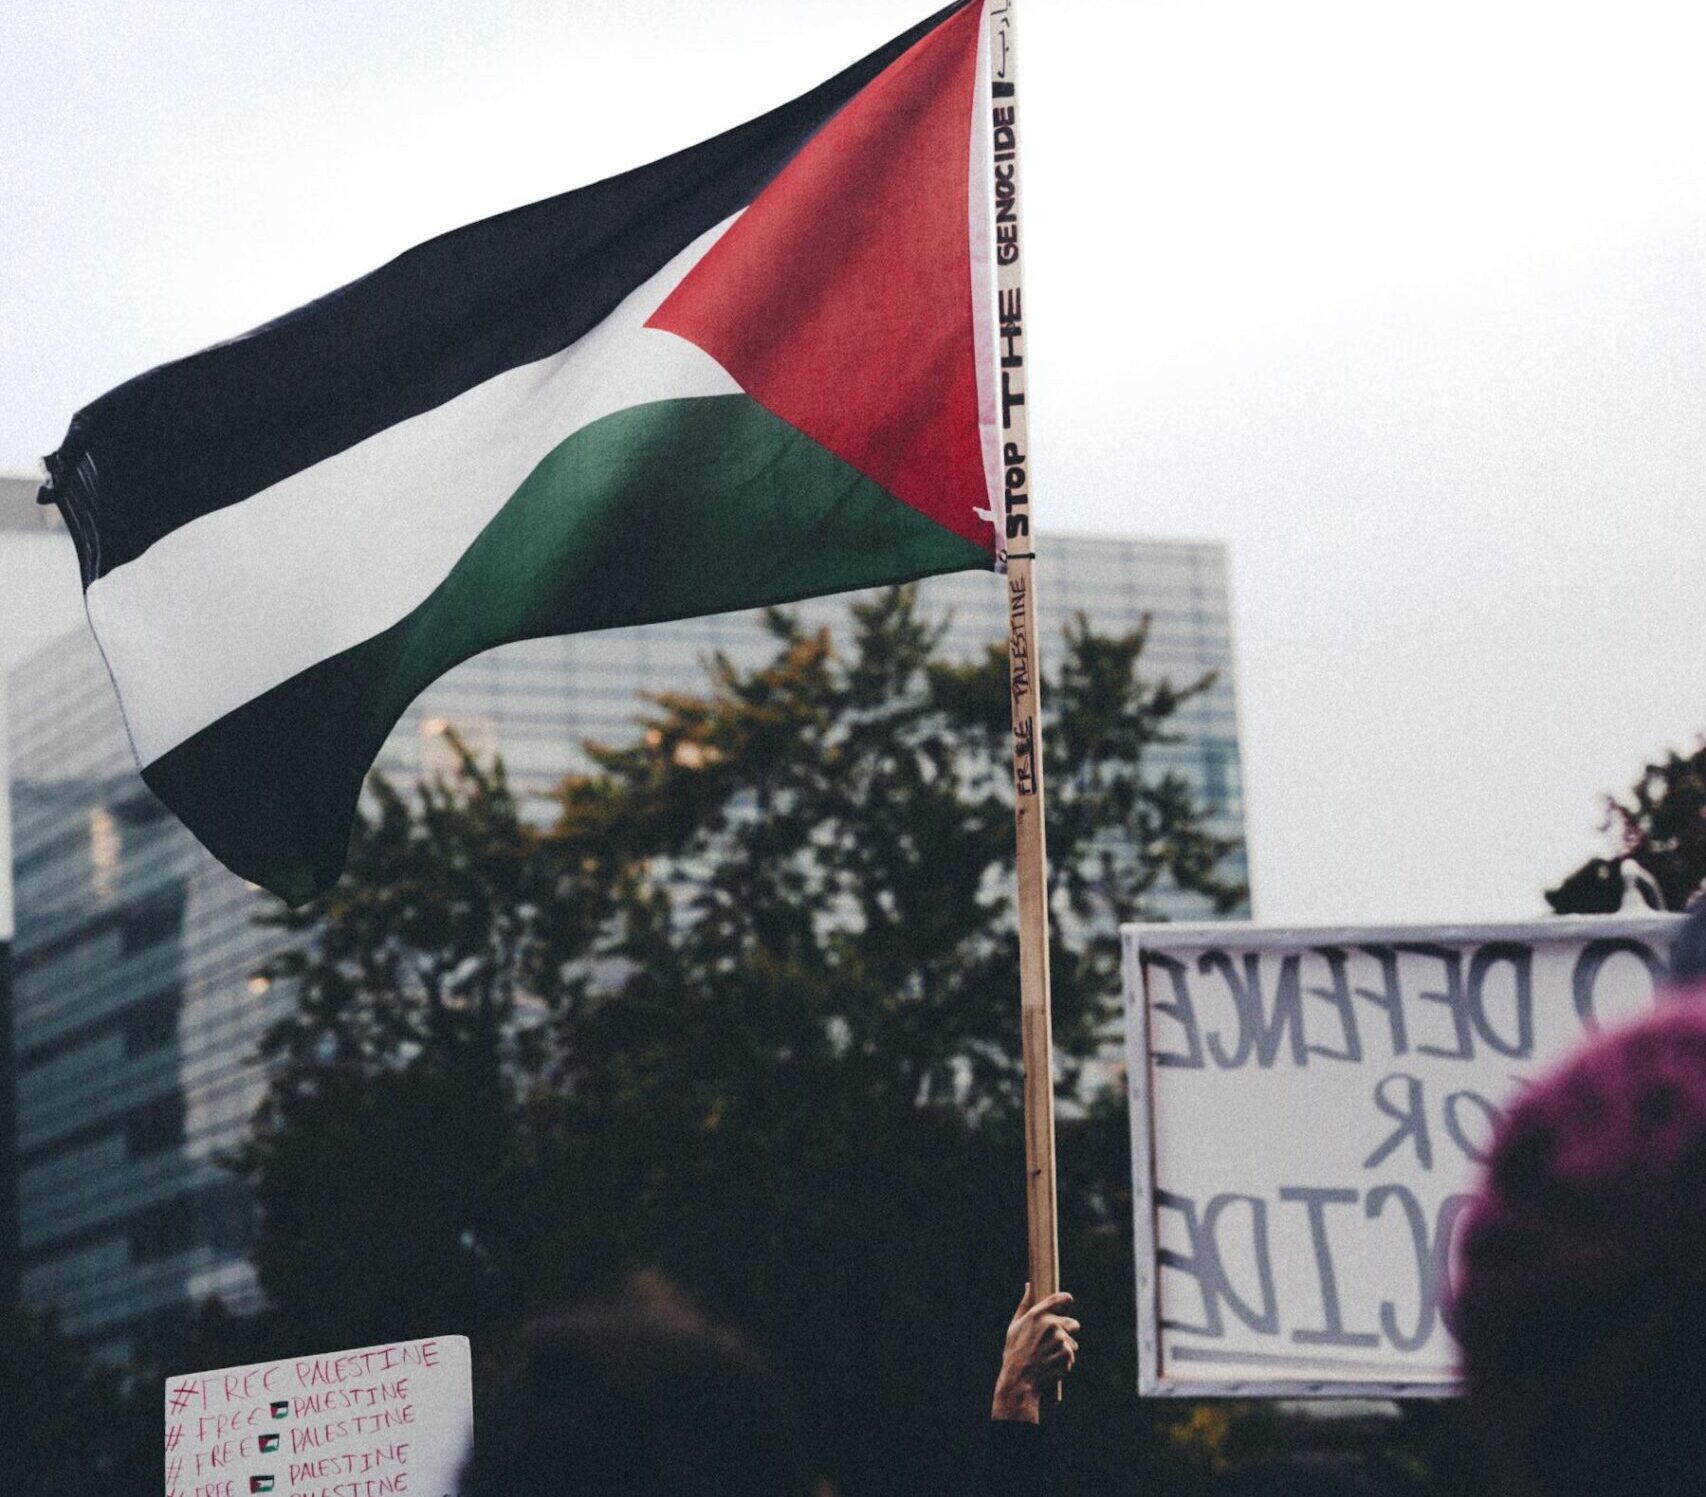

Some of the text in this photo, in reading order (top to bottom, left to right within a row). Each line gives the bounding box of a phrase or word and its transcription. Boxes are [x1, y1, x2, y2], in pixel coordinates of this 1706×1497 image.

[992, 106, 1029, 539] STOP THE GENOCIDE
[1010, 575, 1034, 796] FREE PALESTINE
[296, 1342, 439, 1387] PALESTINE
[196, 1437, 252, 1476] FREE
[291, 1405, 414, 1454] PALESTINE
[198, 1408, 262, 1441] FREE
[292, 1378, 408, 1418] PALESTINE
[289, 1444, 408, 1486] PALESTINE
